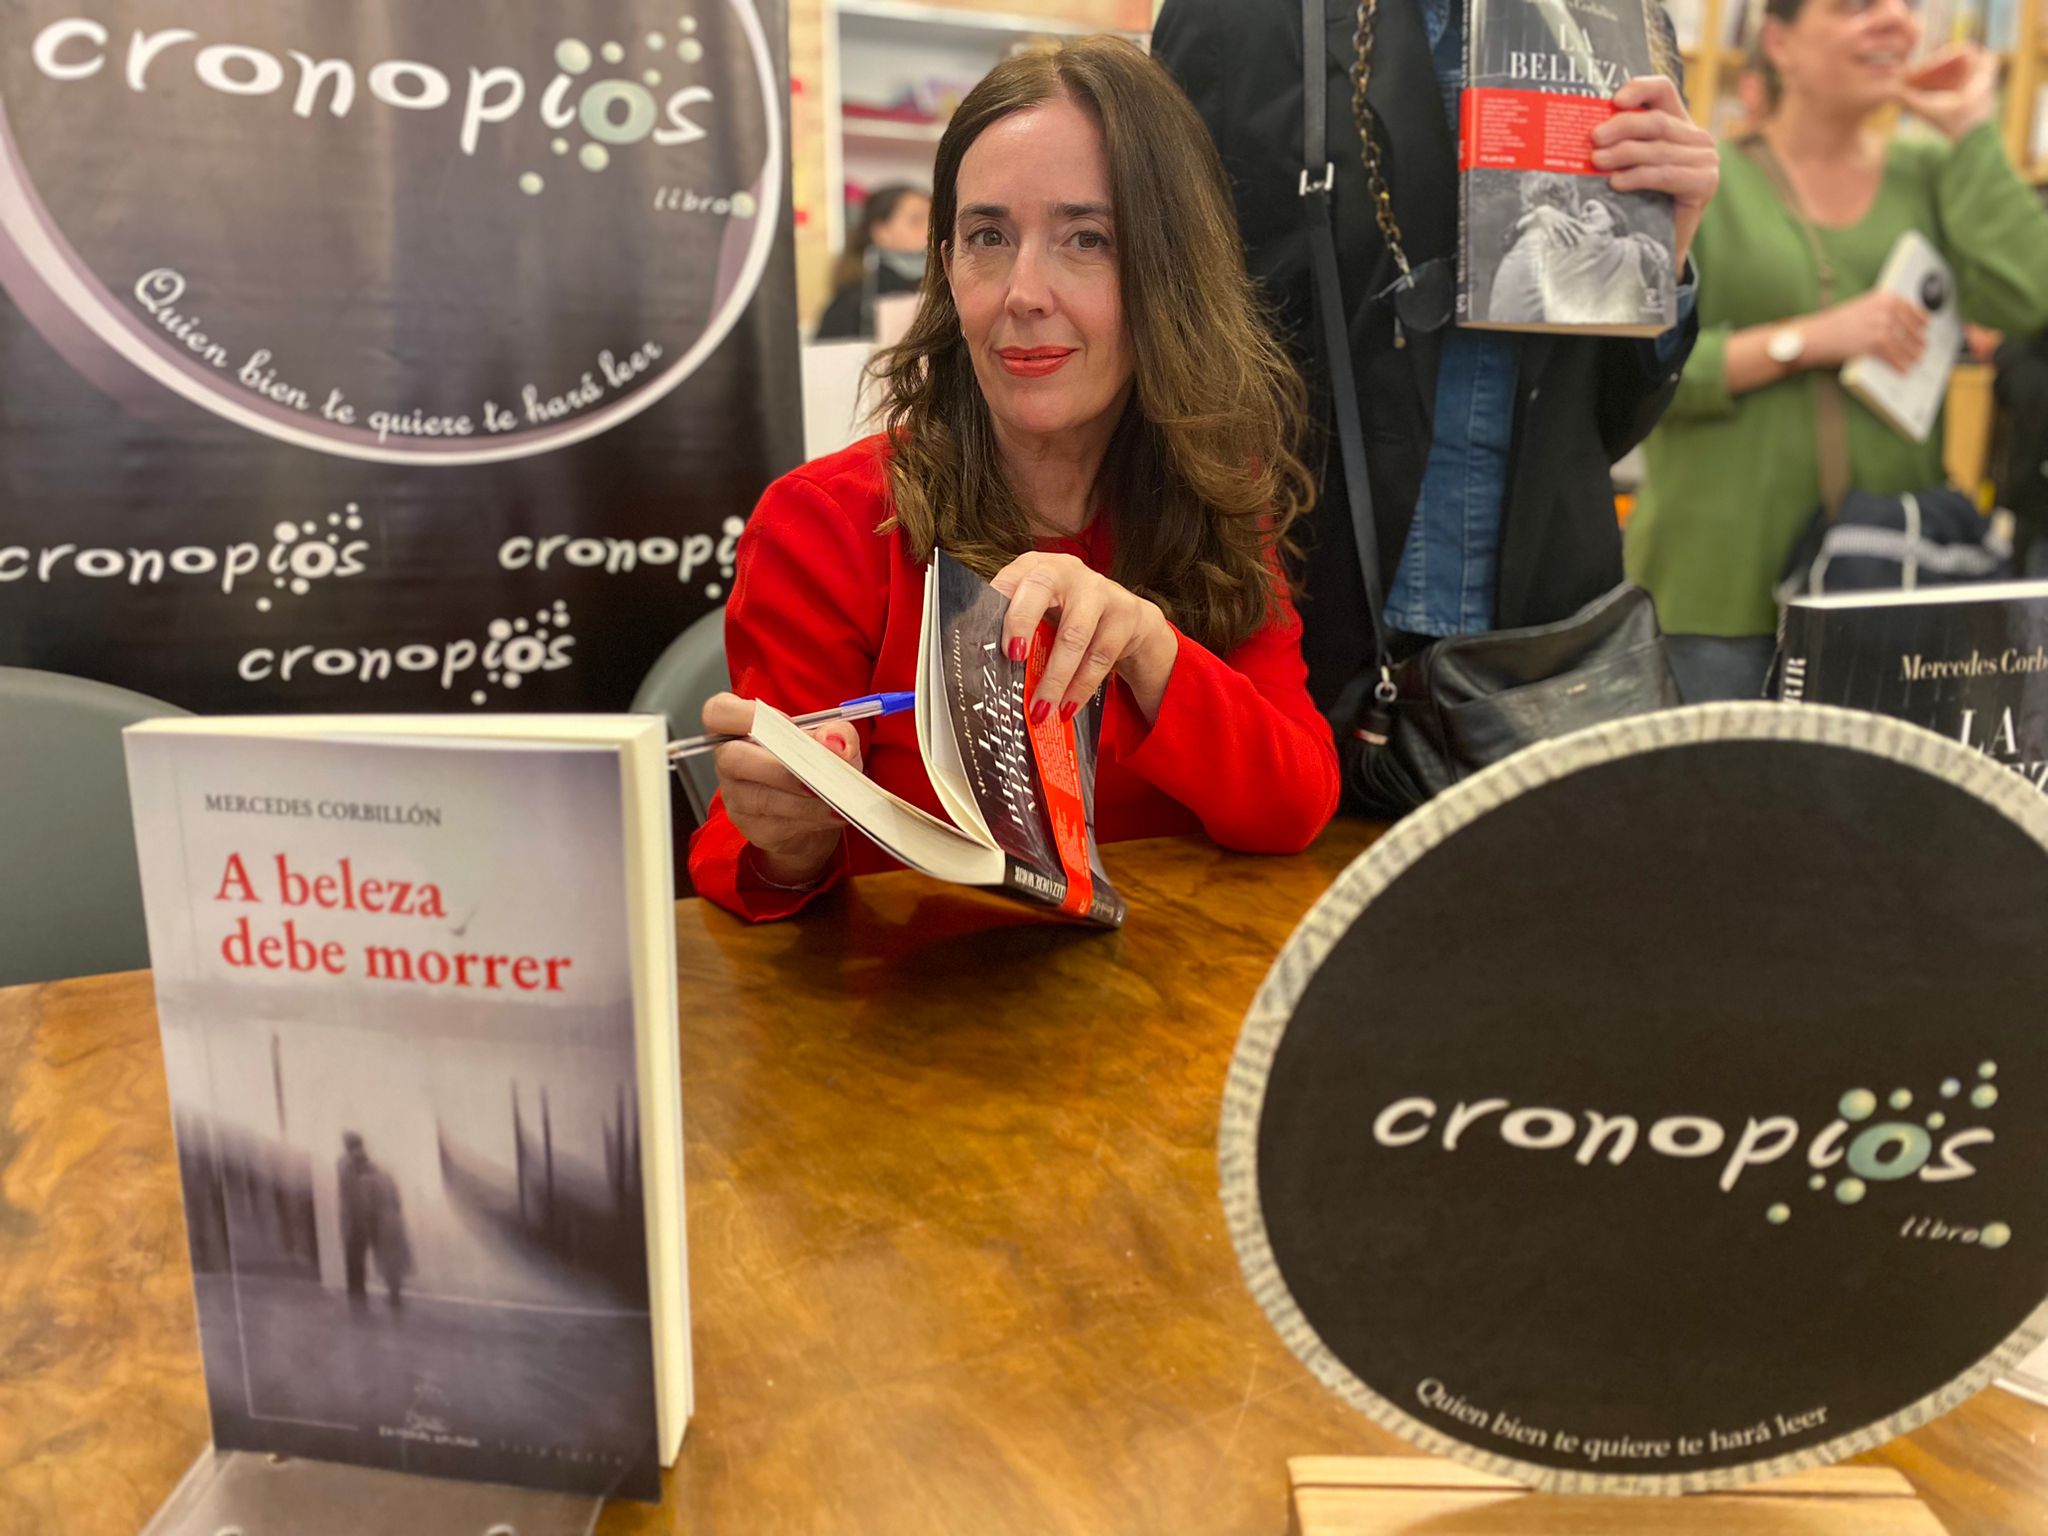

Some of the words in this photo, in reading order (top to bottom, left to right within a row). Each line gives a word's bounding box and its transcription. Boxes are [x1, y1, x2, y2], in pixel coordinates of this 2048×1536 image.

[32, 17, 713, 156] cronopios
[655, 187, 755, 217] libro
[134, 268, 228, 369] Quien
[238, 351, 309, 411] bien
[321, 387, 355, 425] te
[368, 409, 473, 443] quiere
[484, 398, 516, 431] te
[524, 373, 601, 423] hará
[602, 341, 661, 392] leer
[499, 517, 745, 583] cronopi
[238, 619, 575, 688] cronopios
[1902, 650, 1997, 680] Mercedes
[2001, 646, 2048, 673] Corb
[973, 702, 992, 751] LA
[983, 641, 1024, 826] BELLEZA
[998, 685, 1024, 794] DEBE
[1958, 707, 2019, 756] LA
[205, 794, 313, 817] MERCEDES
[318, 798, 442, 827] CORBILLÓN
[214, 851, 258, 903] A
[275, 853, 446, 918] beleza
[221, 916, 345, 974] debe
[366, 946, 572, 992] morrer
[1373, 1088, 1994, 1192] cronopios
[1900, 1215, 2010, 1247] libro
[1416, 1377, 1489, 1428] Quien
[1492, 1410, 1549, 1449] bien
[1554, 1427, 1579, 1452] te
[1583, 1435, 1671, 1463] quiere
[1677, 1431, 1702, 1457] te
[1709, 1417, 1770, 1450] hará
[1777, 1403, 1829, 1437] leer
